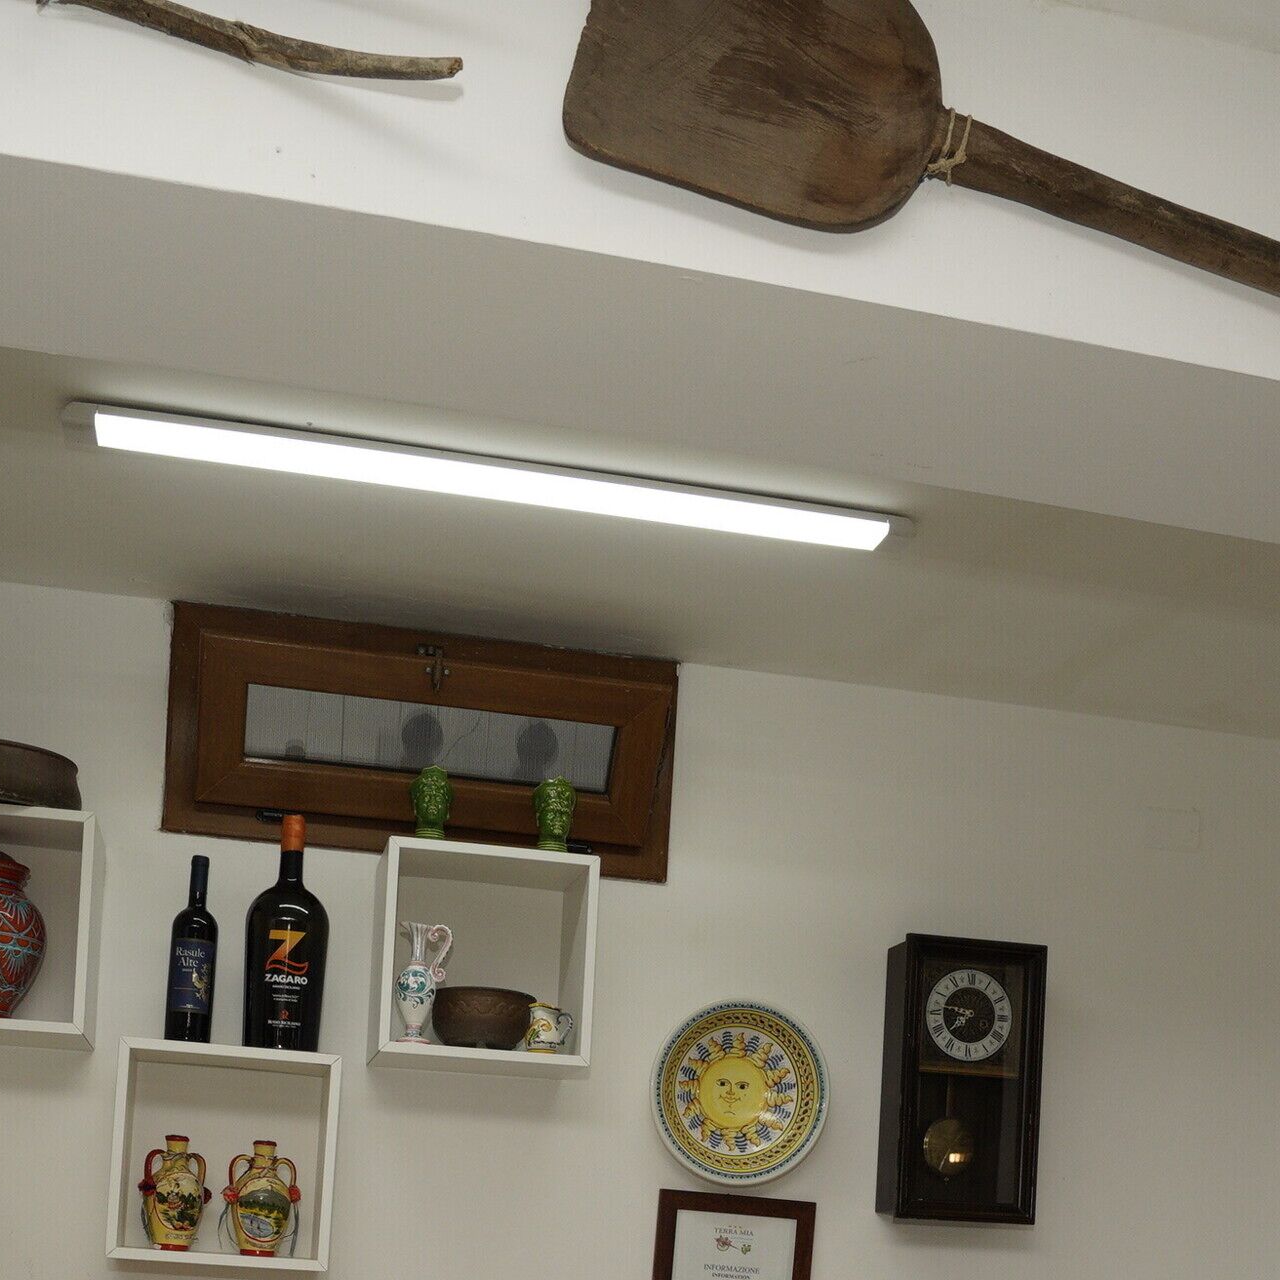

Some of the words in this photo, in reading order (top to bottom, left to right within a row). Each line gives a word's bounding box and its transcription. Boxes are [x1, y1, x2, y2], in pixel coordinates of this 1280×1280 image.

[176, 946, 205, 958] Rasule
[178, 957, 199, 967] Alte
[265, 974, 308, 985] ZAGARO
[714, 1227, 738, 1236] TERRA
[739, 1229, 754, 1237] MIA
[703, 1264, 760, 1275] INFORMAZIONE
